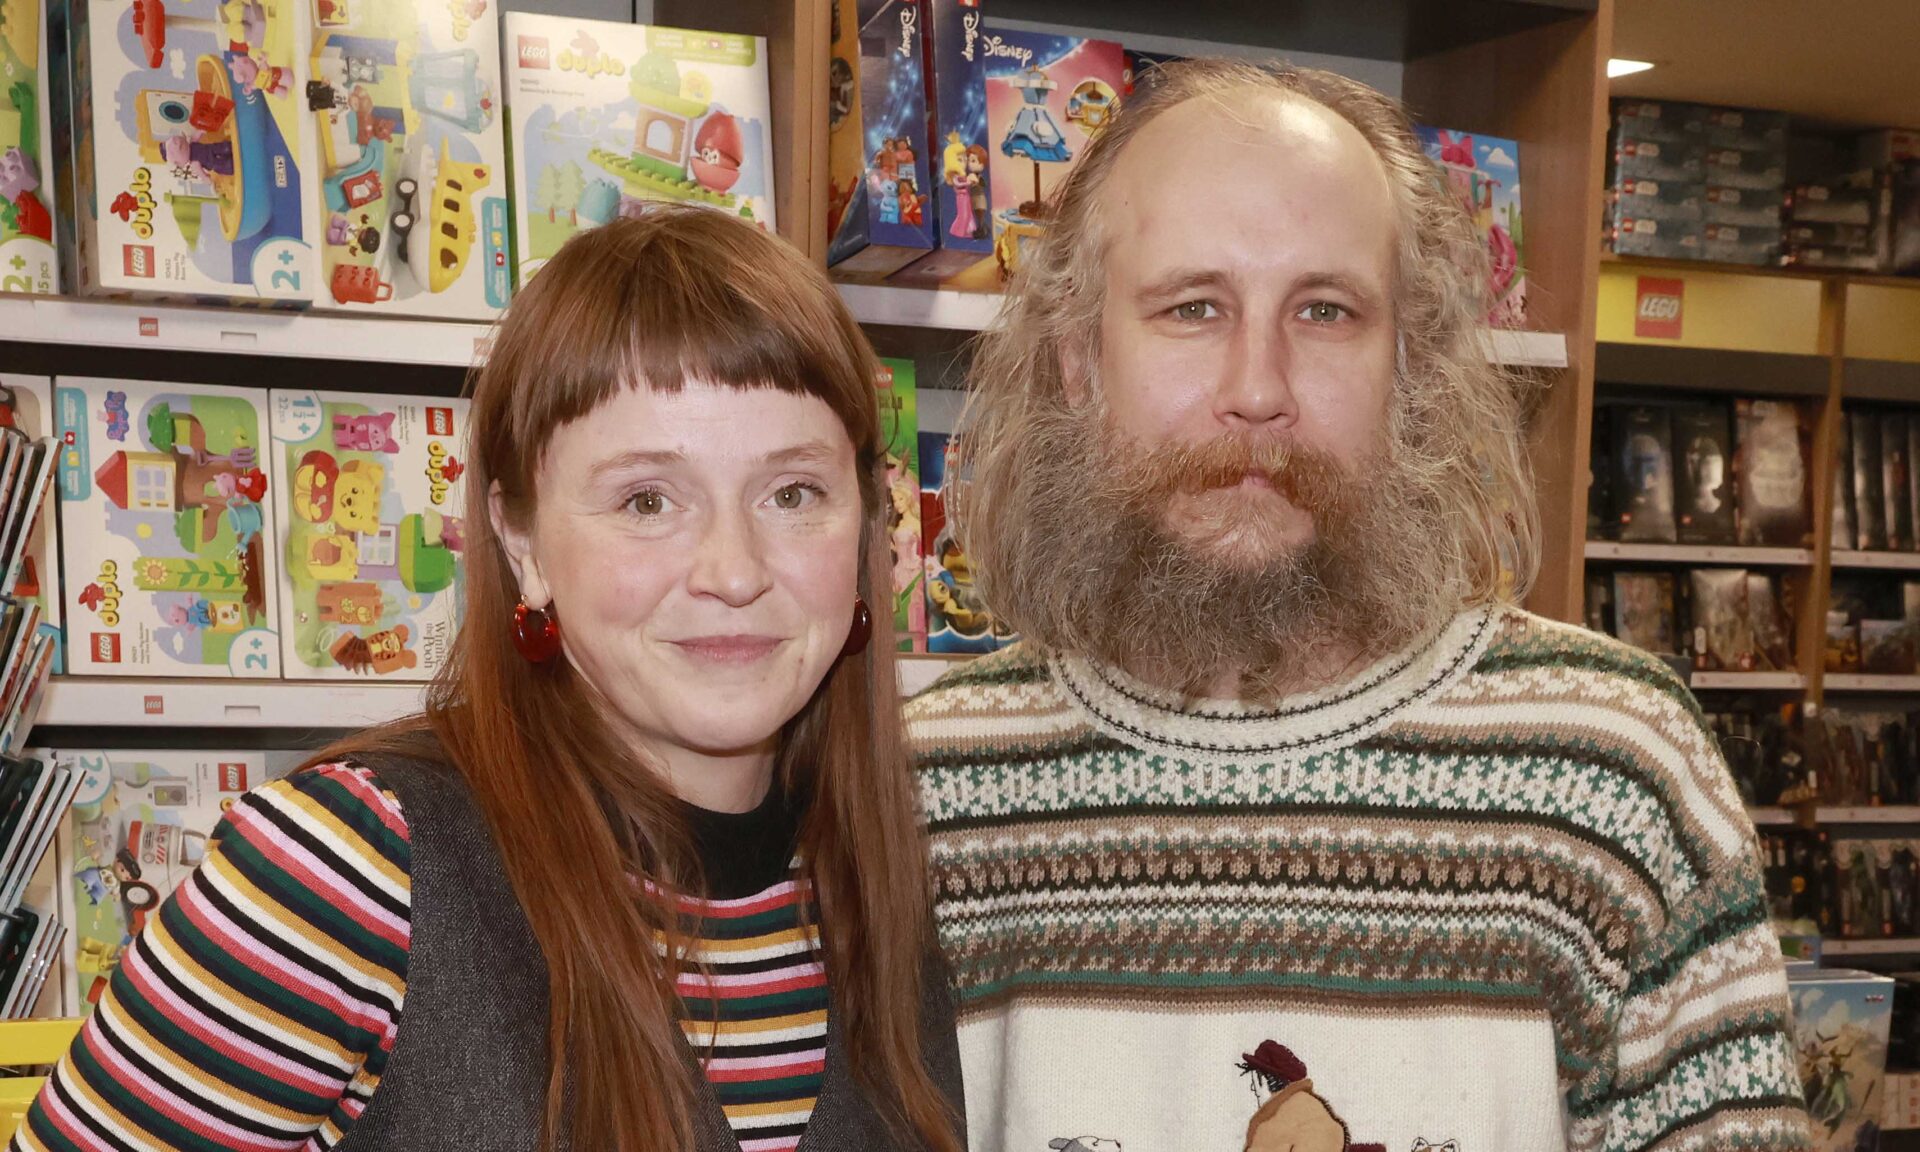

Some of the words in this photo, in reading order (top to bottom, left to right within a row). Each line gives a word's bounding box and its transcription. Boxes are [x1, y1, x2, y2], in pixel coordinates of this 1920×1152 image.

[897, 6, 916, 58] Disney
[961, 10, 979, 62] Disney
[523, 46, 546, 58] LEGO
[556, 48, 626, 80] duplo
[982, 36, 1032, 67] Disney
[131, 167, 157, 240] duplo
[132, 246, 146, 275] LEGO
[1639, 295, 1680, 319] LEGO
[432, 408, 447, 435] LEGO
[425, 440, 449, 505] duplo
[97, 559, 123, 627] duplo
[100, 634, 114, 661] LEGO
[423, 637, 436, 668] Pooh
[226, 765, 239, 791] LEGO
